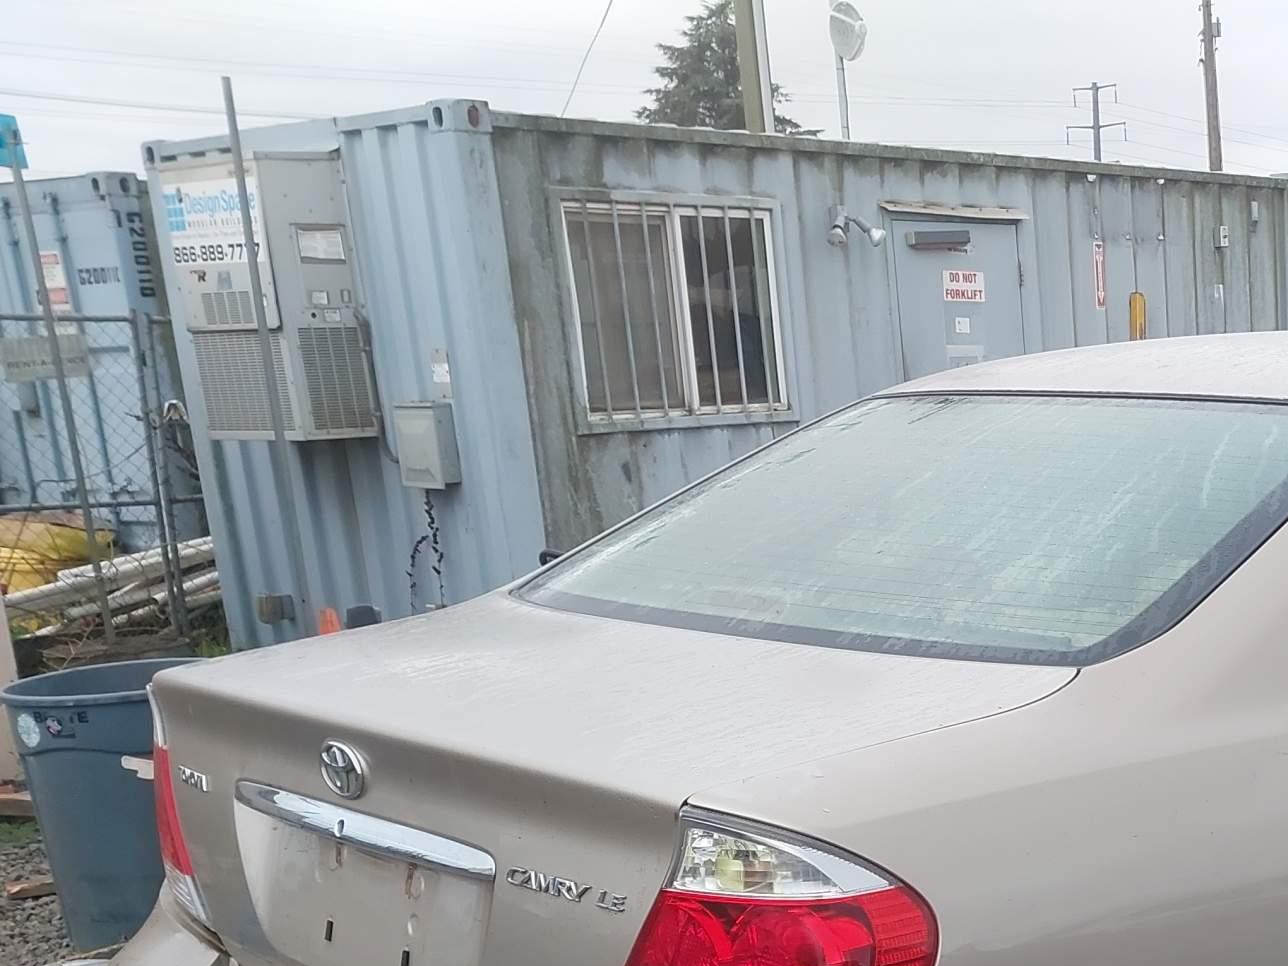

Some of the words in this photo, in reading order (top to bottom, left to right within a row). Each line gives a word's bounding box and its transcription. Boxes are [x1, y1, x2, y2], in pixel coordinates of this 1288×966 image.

[183, 190, 256, 217] DesignSpae
[126, 211, 156, 298] G200110
[173, 242, 260, 263] 866-889-777
[949, 271, 960, 283] DO
[962, 272, 977, 284] NOT
[945, 288, 983, 300] FORKLIFT
[506, 866, 592, 902] CAMRY
[594, 889, 628, 912] LE
